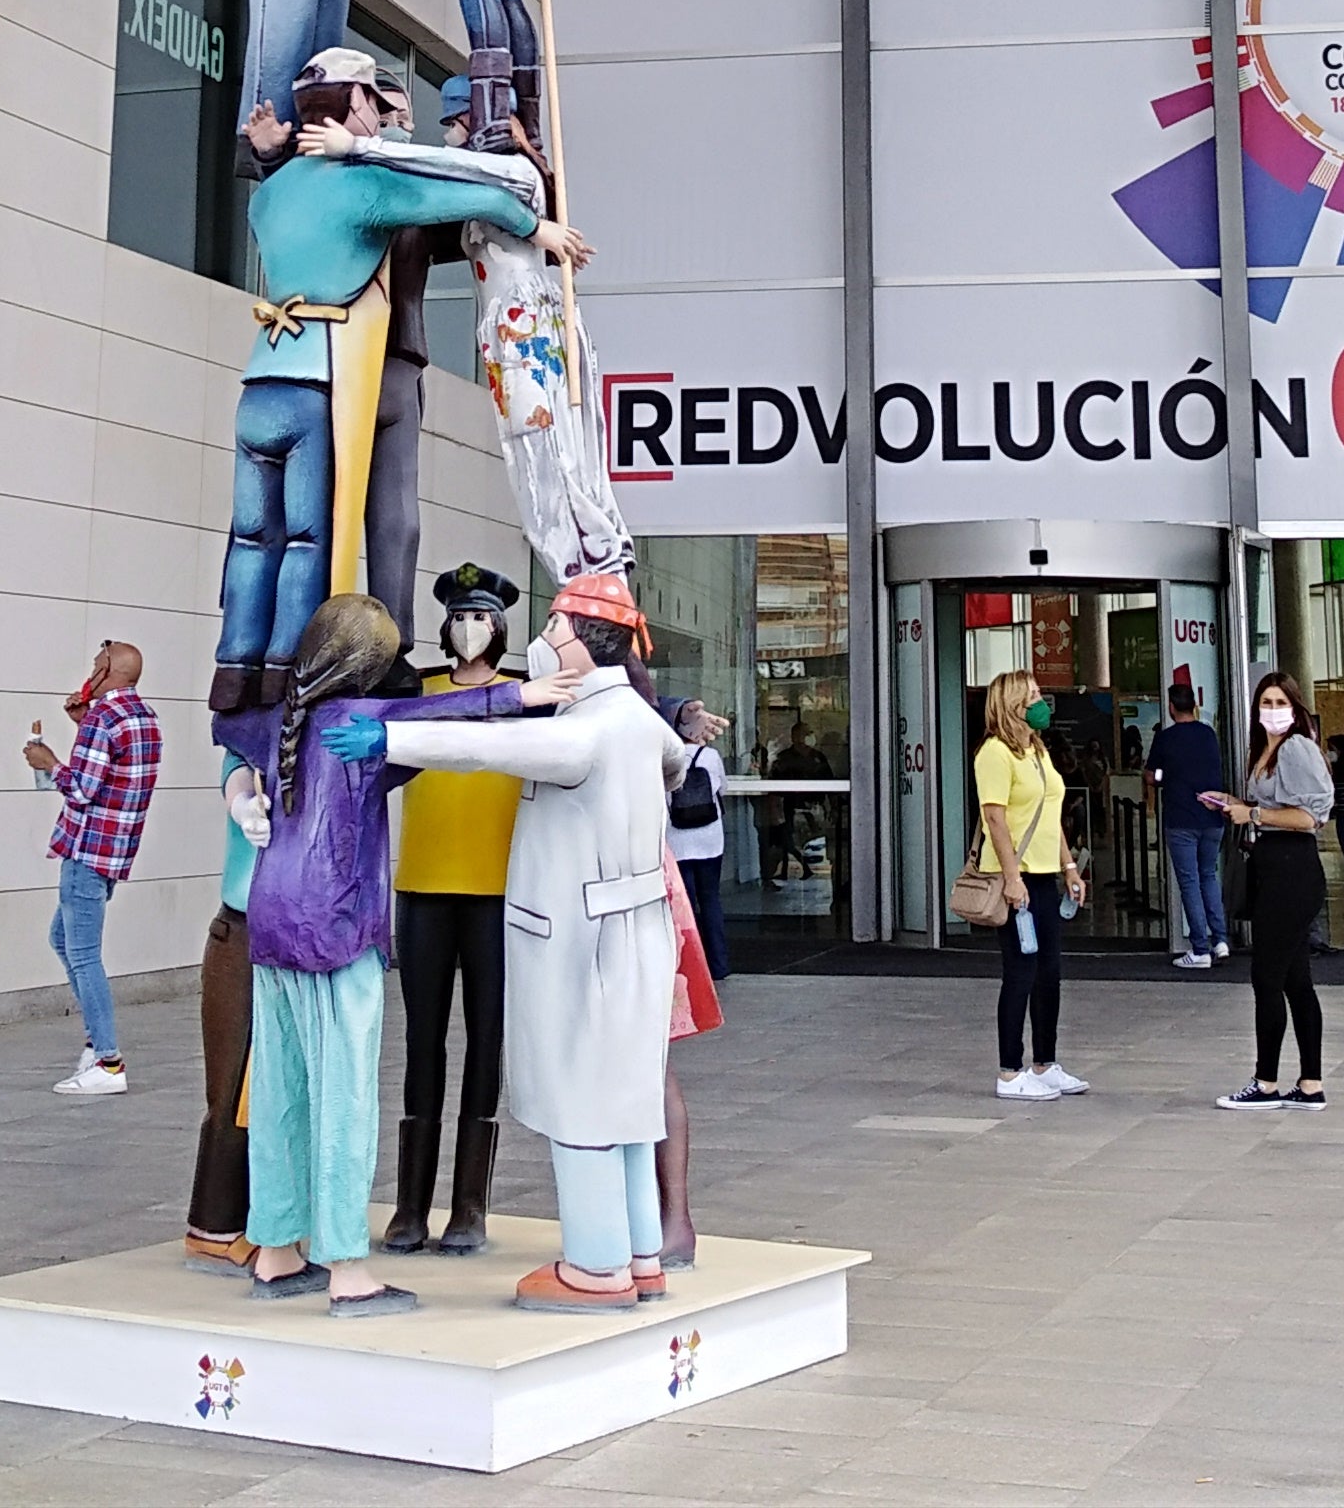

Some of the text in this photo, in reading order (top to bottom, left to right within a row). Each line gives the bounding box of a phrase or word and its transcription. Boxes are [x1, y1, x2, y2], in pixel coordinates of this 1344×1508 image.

[615, 357, 1310, 467] REDVOLUCIÓN
[895, 619, 909, 644] GT
[1174, 618, 1207, 644] UGT
[904, 743, 925, 773] 6.0
